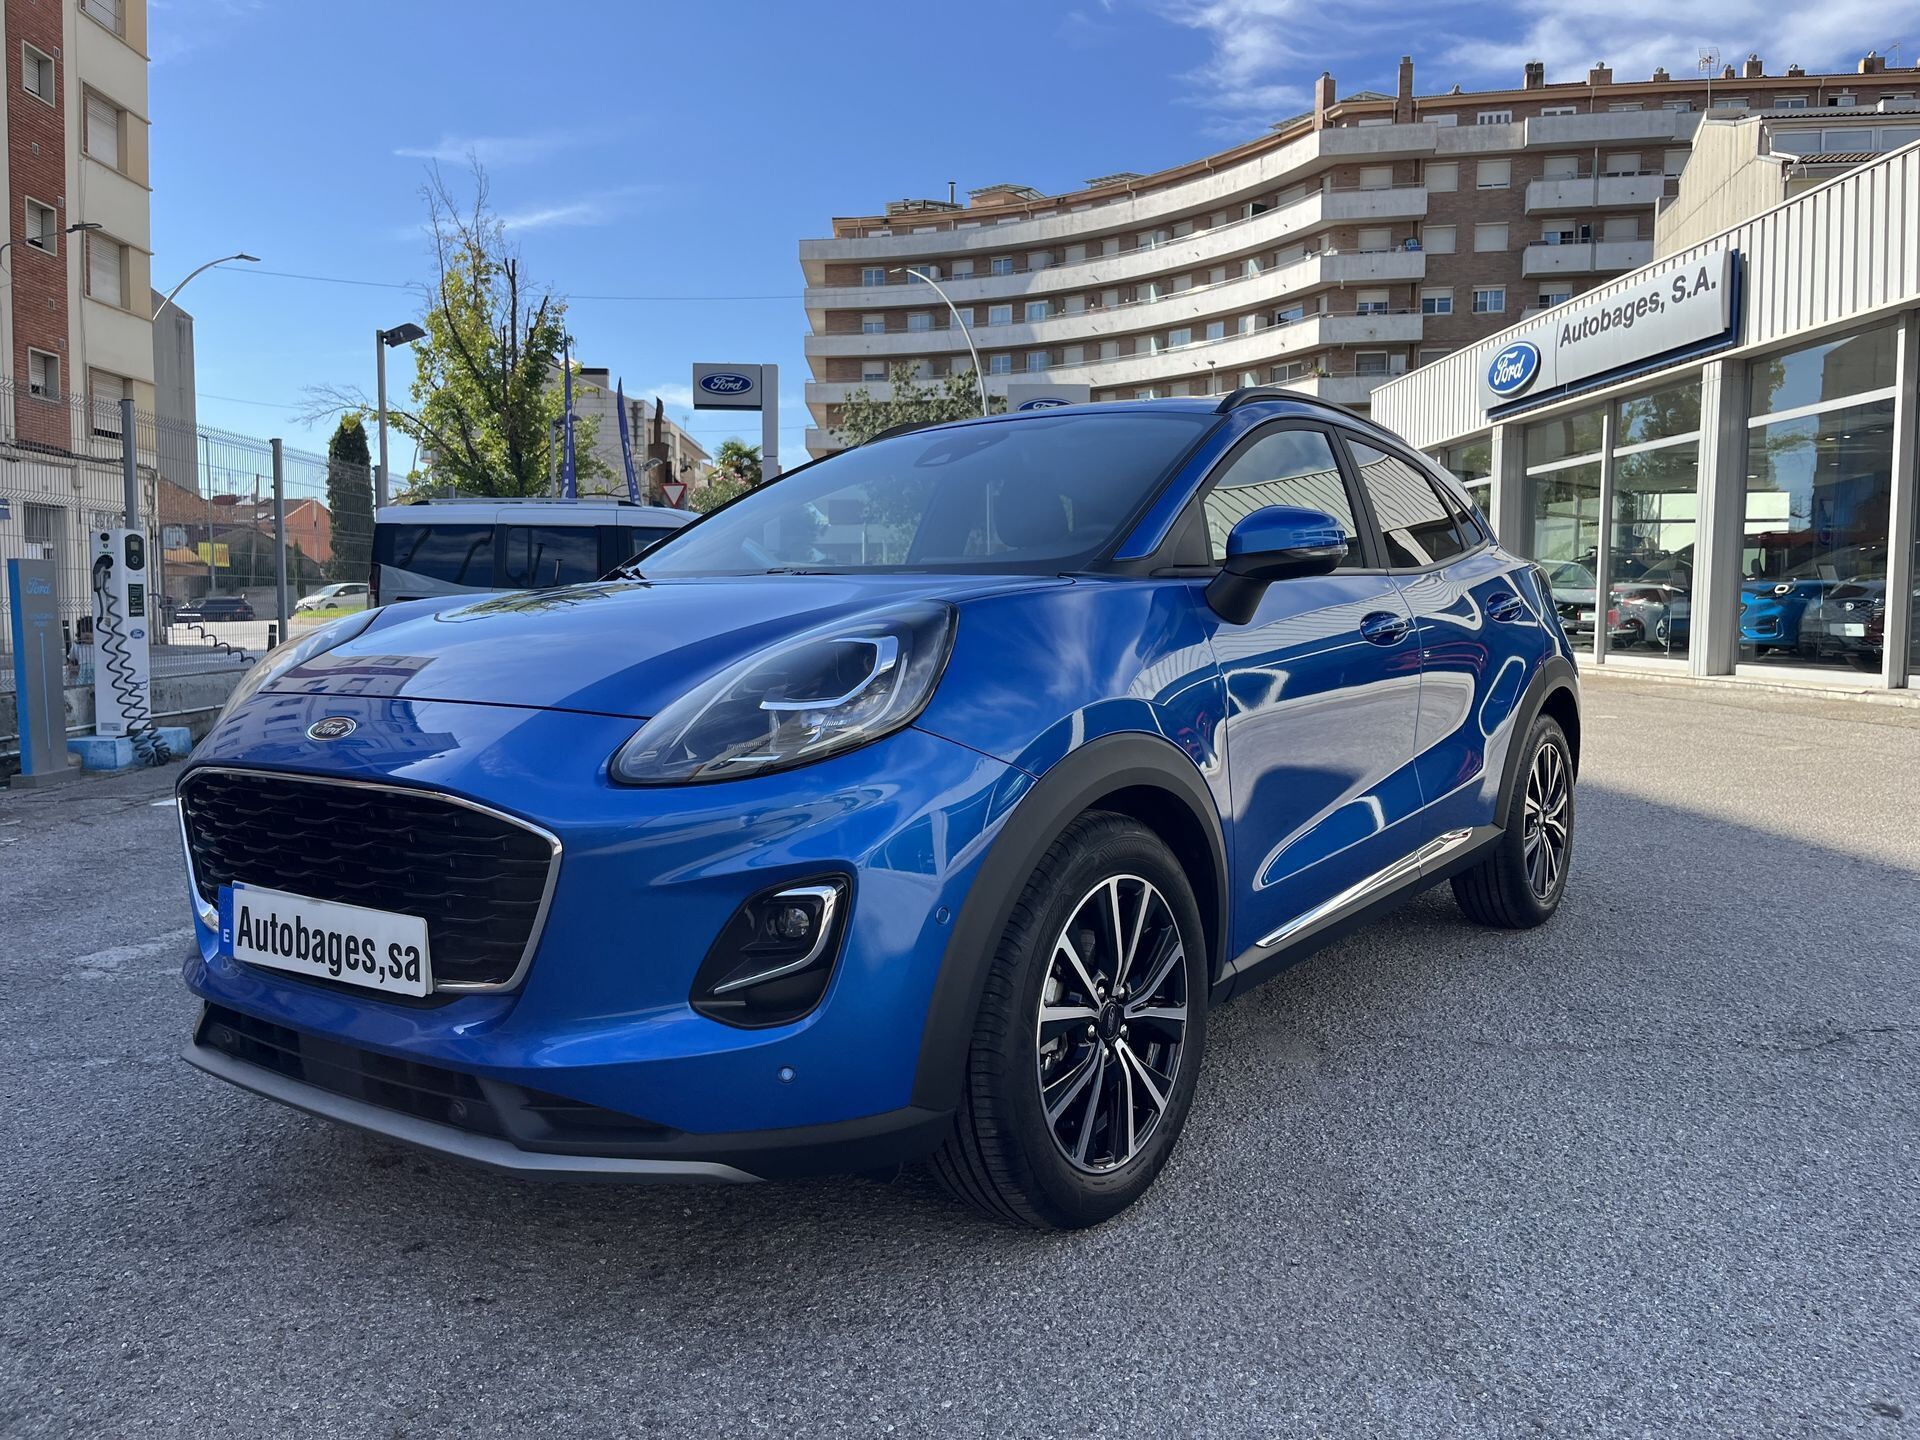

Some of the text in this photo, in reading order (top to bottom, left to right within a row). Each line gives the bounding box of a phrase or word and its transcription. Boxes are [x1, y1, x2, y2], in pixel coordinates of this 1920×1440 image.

[1560, 266, 1717, 348] Autobages, S.A.
[1493, 350, 1525, 386] Ford
[710, 376, 743, 391] Ford
[26, 576, 50, 595] Ford
[315, 721, 346, 736] Ford
[223, 928, 230, 943] E
[236, 905, 421, 984] Autobages,sa
